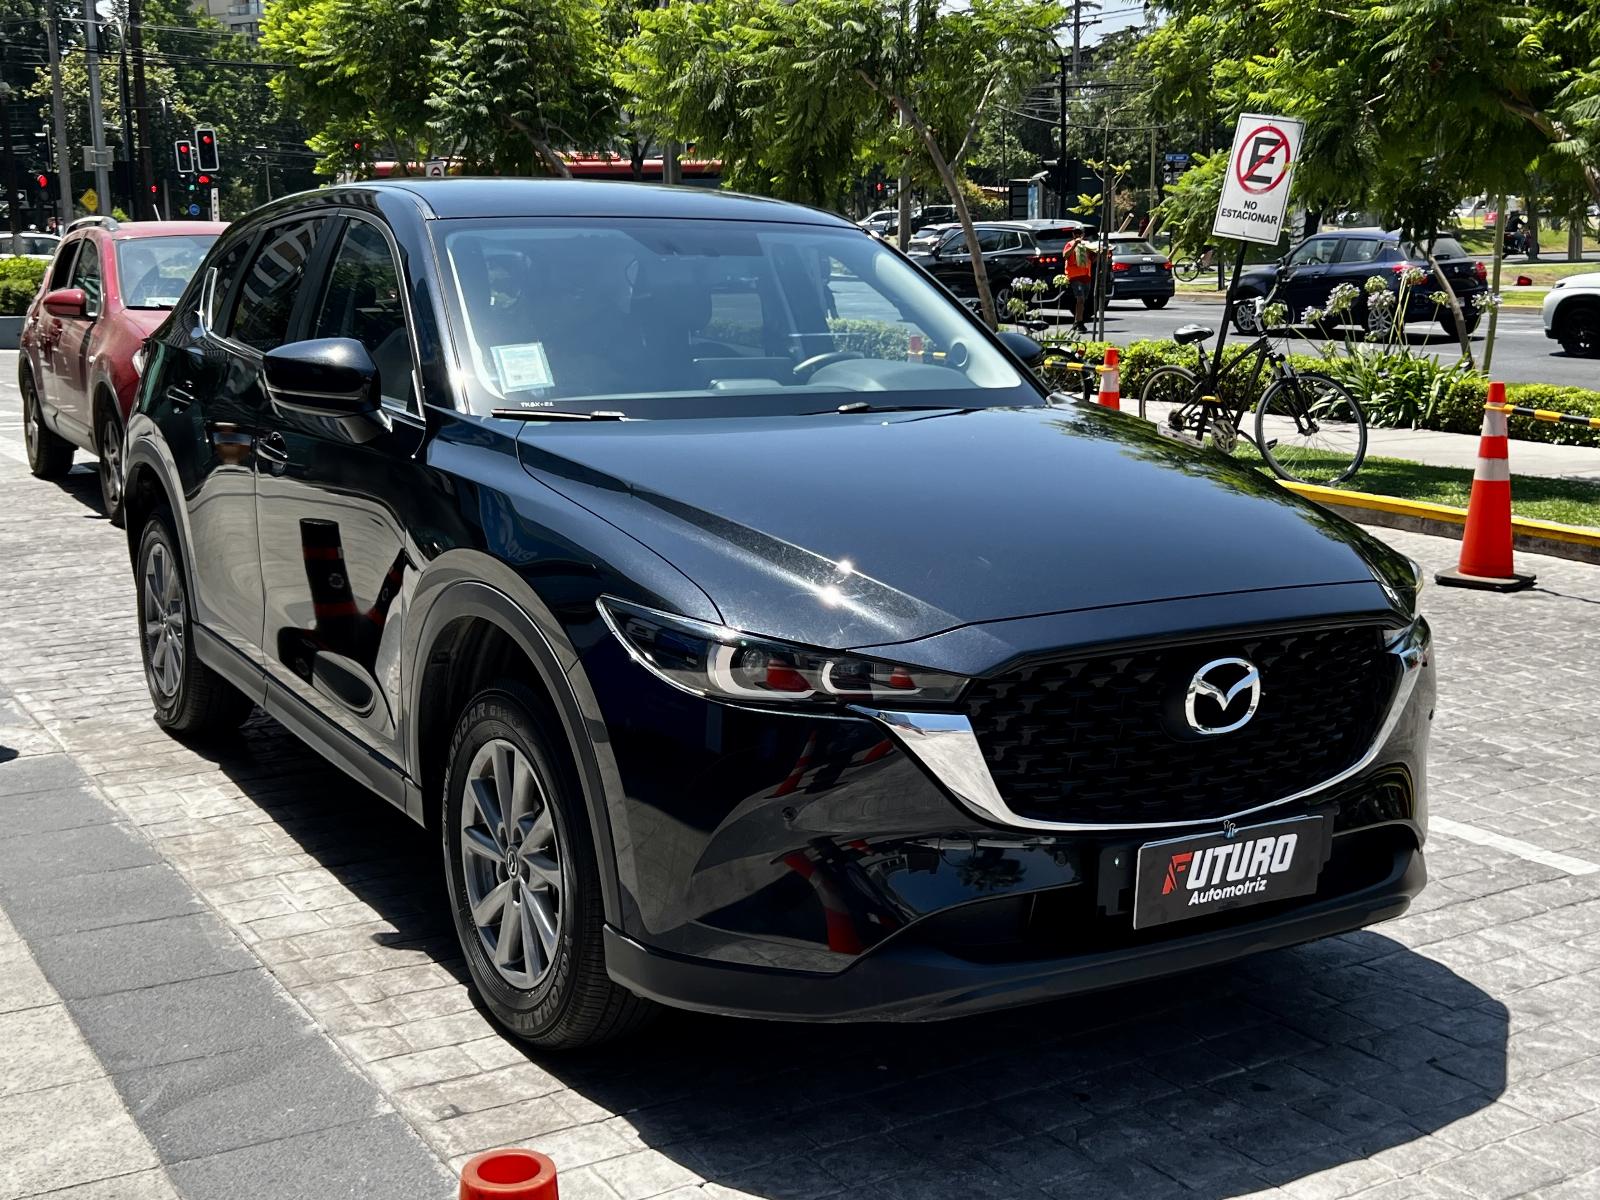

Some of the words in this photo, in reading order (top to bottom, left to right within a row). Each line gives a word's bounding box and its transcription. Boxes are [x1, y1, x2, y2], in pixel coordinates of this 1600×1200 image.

[1245, 137, 1280, 184] E
[1221, 208, 1278, 225] ESTACIONAR
[1243, 200, 1258, 210] NO
[1161, 833, 1298, 895] FUTURO
[1188, 877, 1268, 906] Automotriz
[513, 934, 575, 1029] YOKOHAMA
